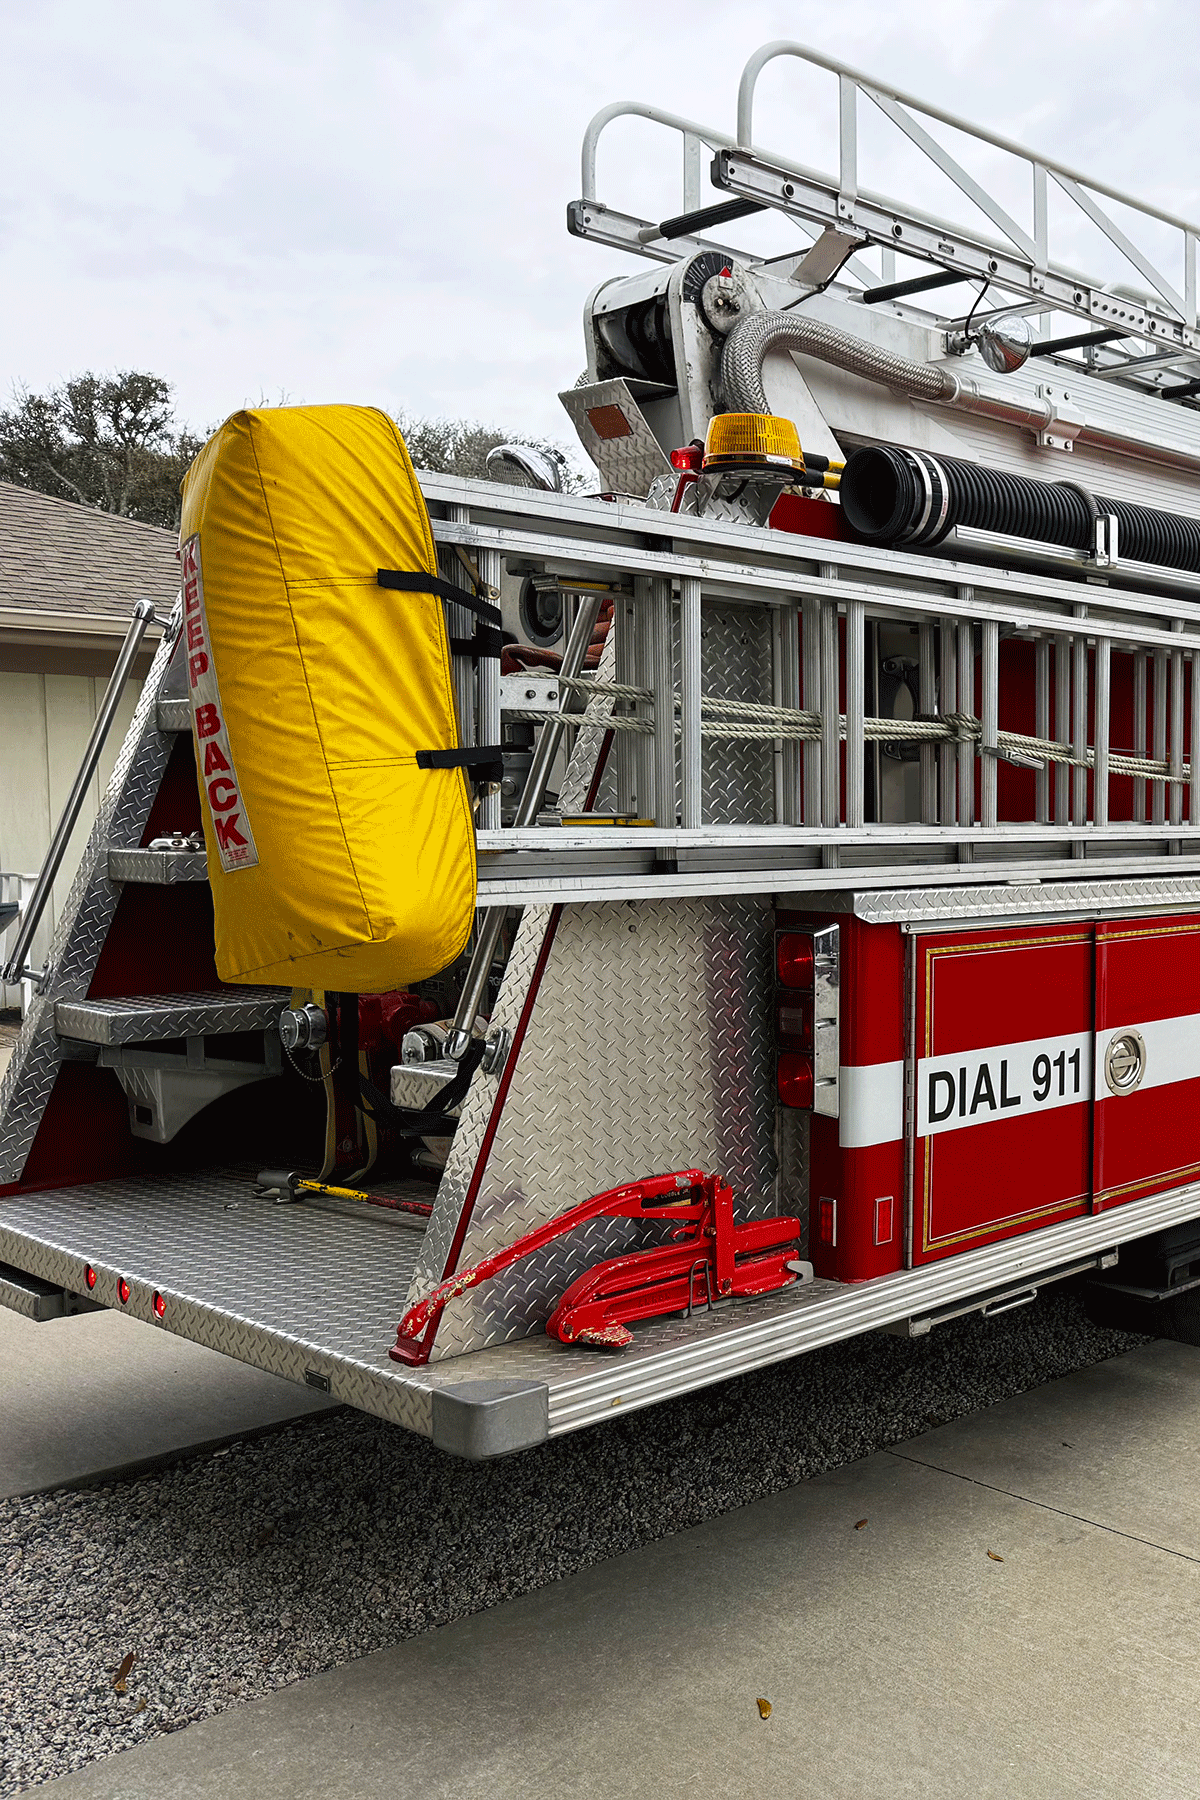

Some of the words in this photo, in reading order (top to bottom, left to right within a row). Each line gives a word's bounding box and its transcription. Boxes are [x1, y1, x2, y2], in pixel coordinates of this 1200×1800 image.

[183, 543, 209, 689] KEEP
[195, 703, 249, 851] BACK
[928, 1059, 1021, 1124] DIAL
[1033, 1047, 1081, 1102] 911
